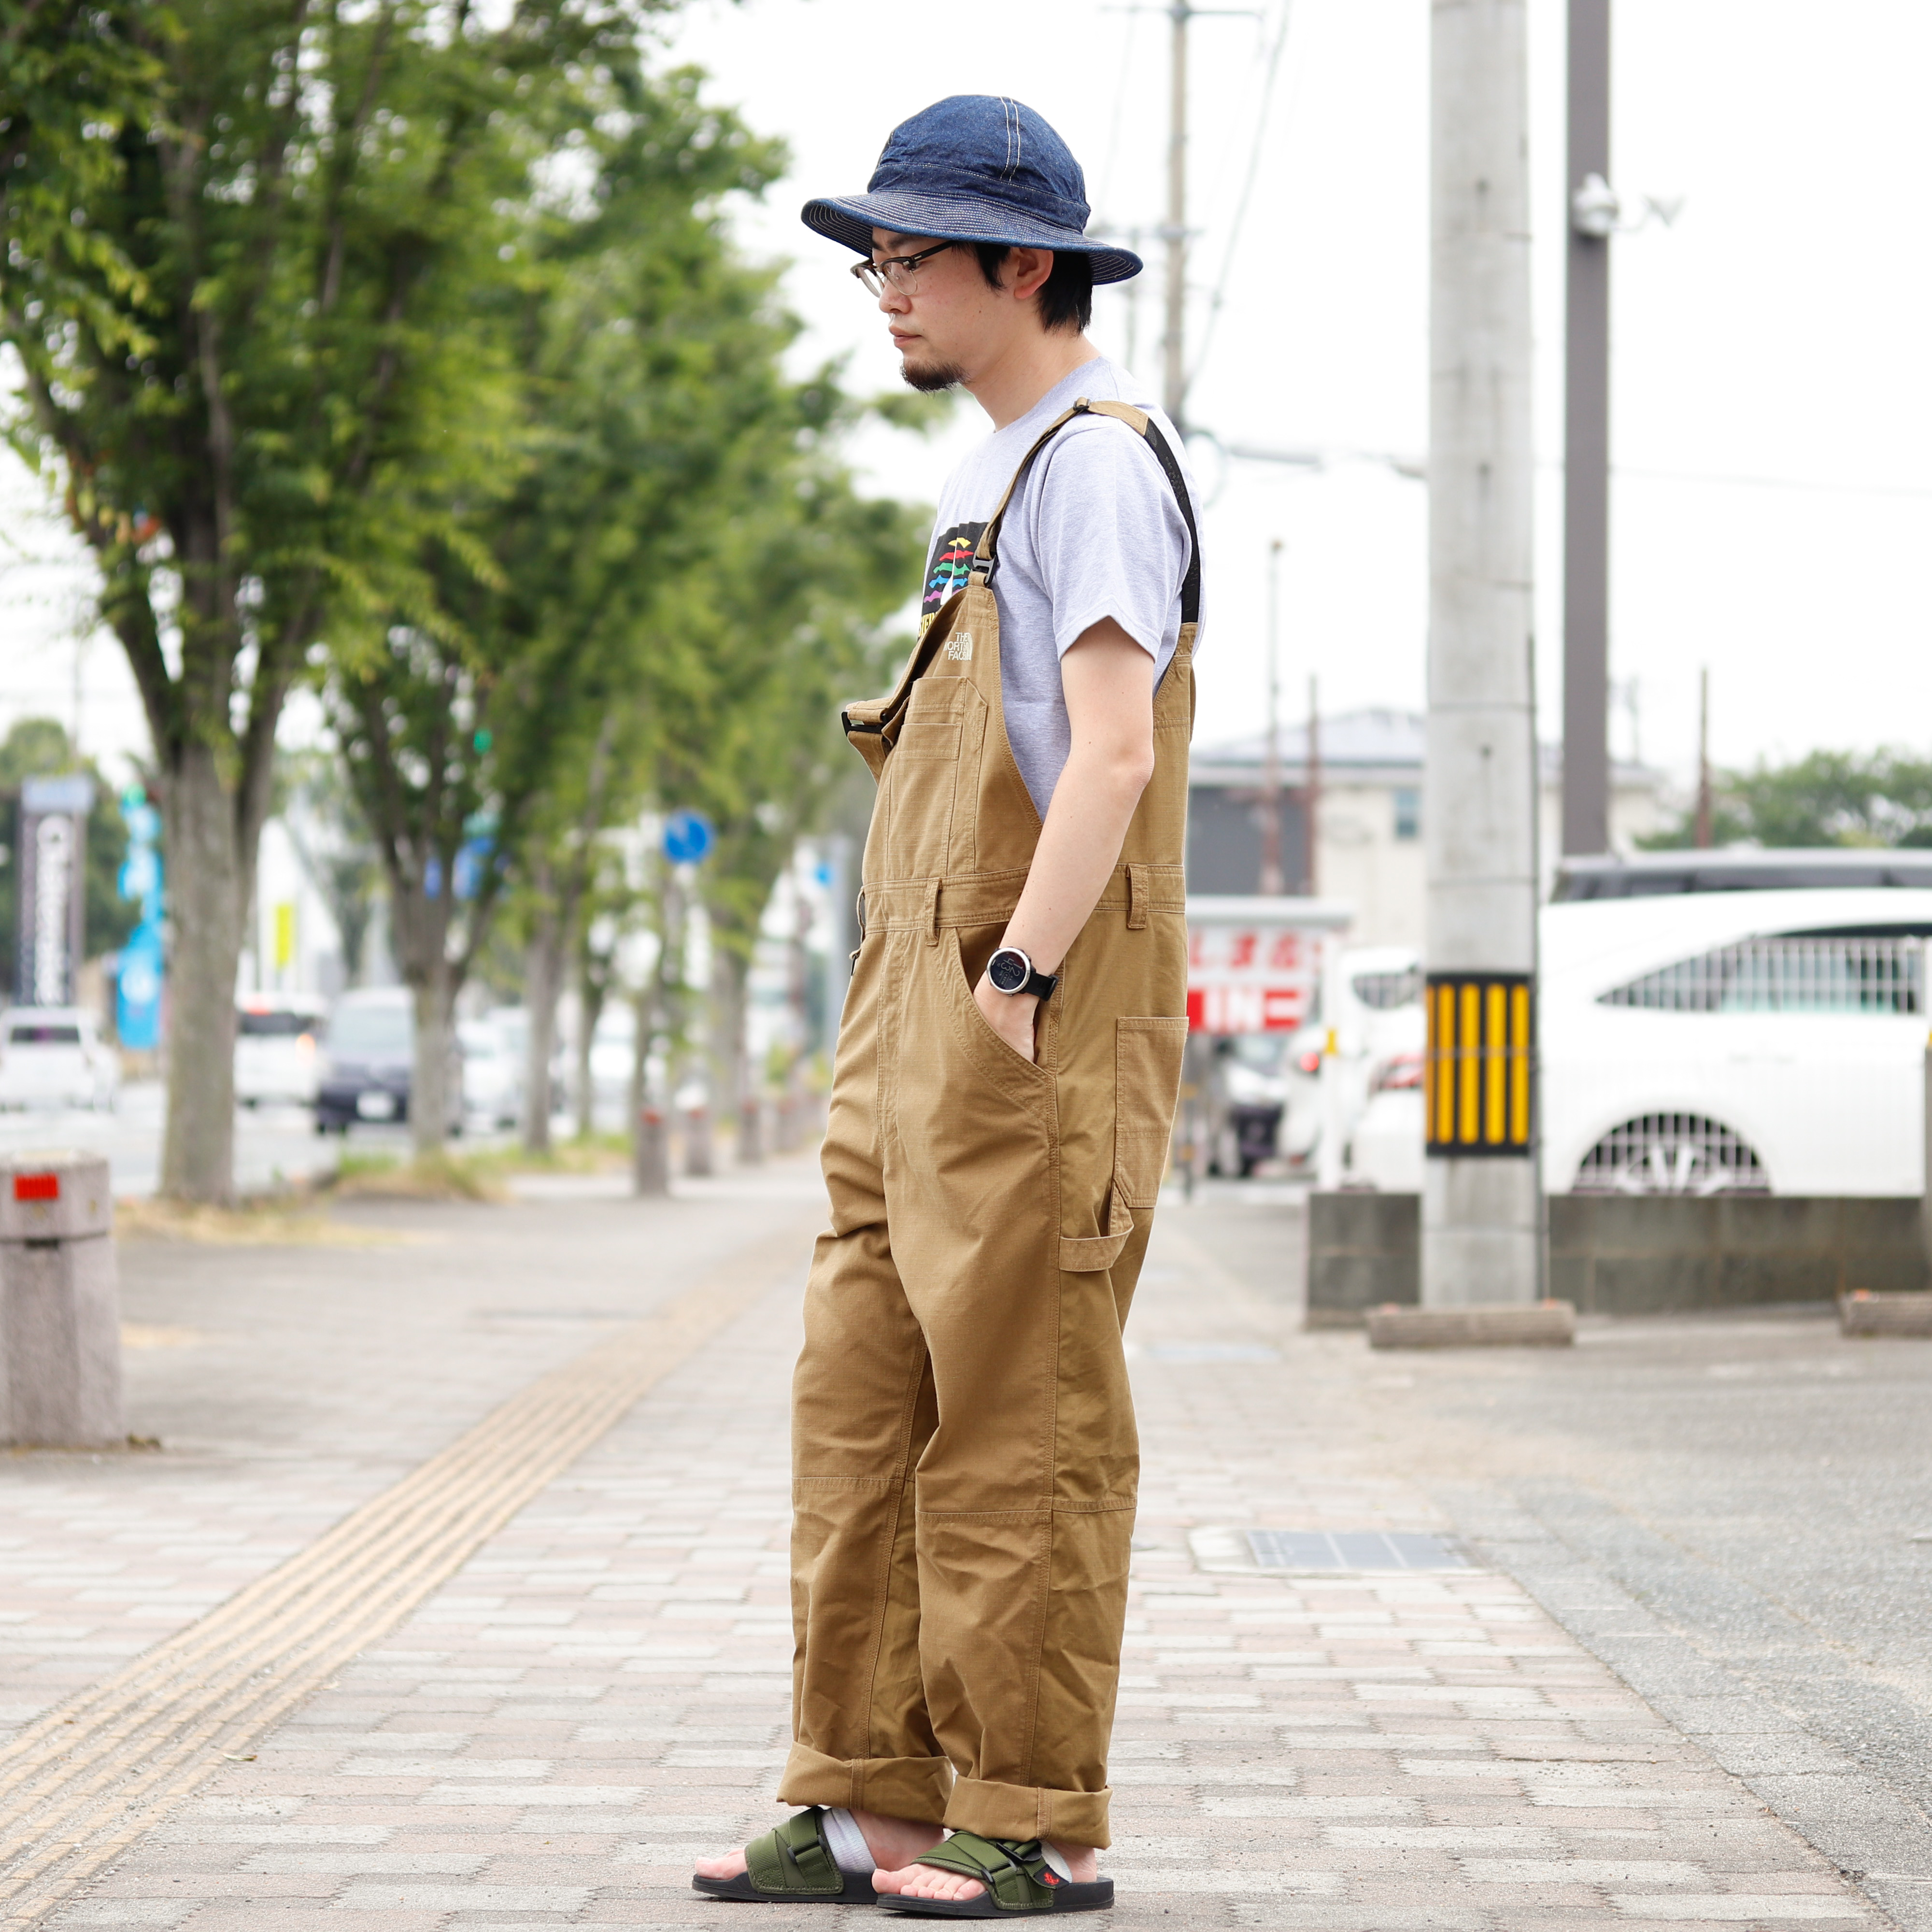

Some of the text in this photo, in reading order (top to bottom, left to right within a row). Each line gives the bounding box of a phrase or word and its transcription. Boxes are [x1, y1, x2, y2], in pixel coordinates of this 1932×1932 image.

[955, 632, 968, 642] THE
[943, 641, 967, 651] NORTH
[948, 651, 967, 661] FACE
